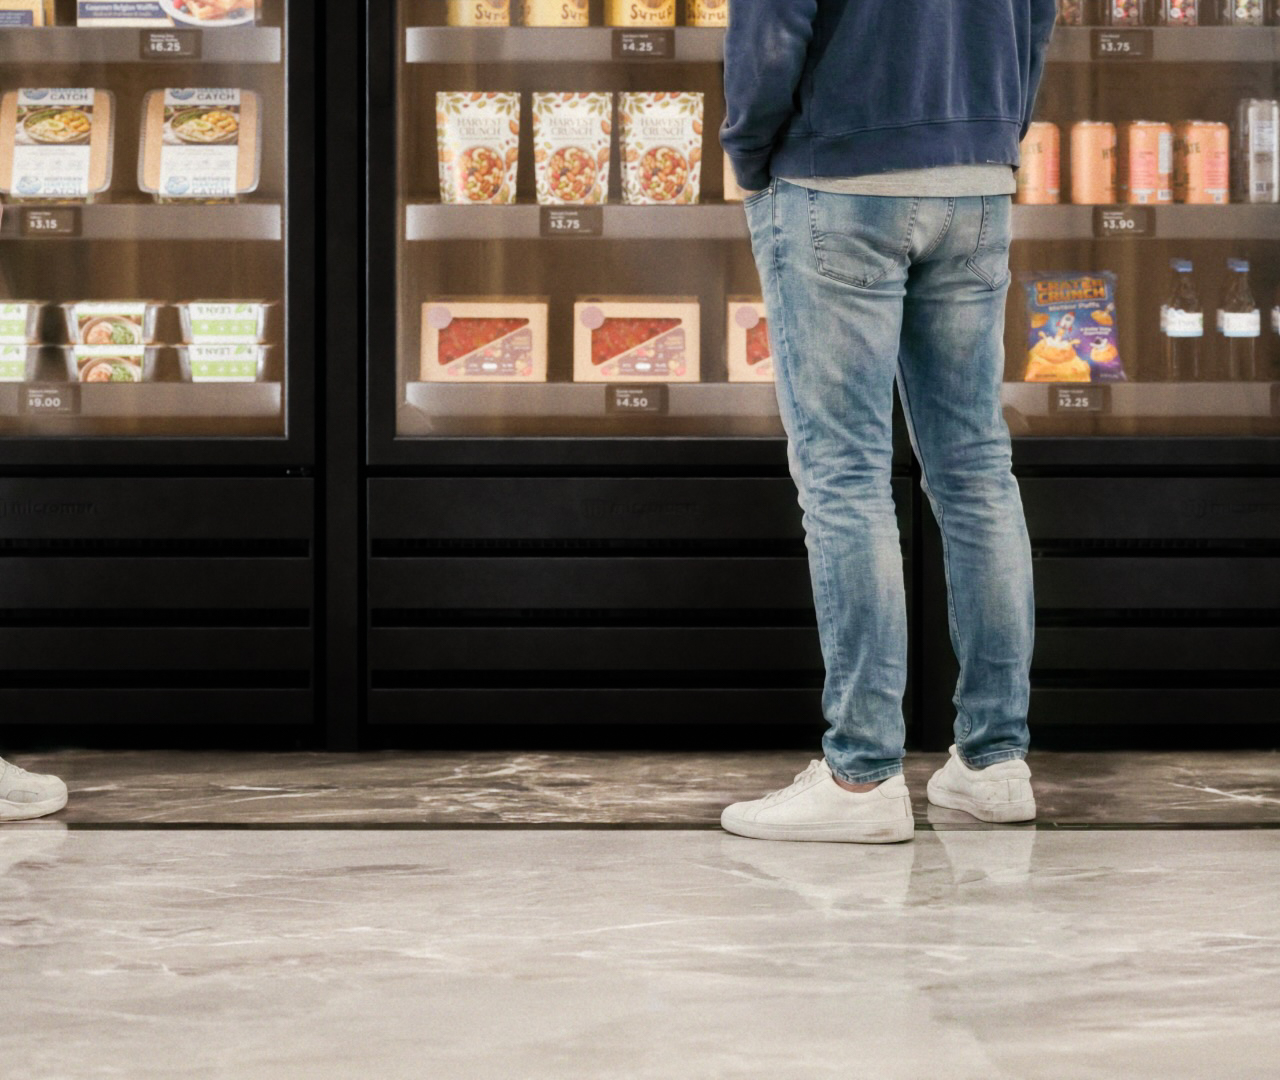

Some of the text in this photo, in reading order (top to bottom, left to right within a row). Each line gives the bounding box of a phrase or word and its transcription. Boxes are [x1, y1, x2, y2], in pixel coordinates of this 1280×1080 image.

[150, 42, 181, 52] $6.25
[622, 42, 653, 52] $4.25
[1101, 42, 1130, 52] $3.75
[49, 93, 88, 101] CATCH
[196, 93, 235, 101] CATCH
[30, 219, 58, 229] $3.15
[551, 219, 580, 229] $3.75
[1103, 219, 1135, 229] $3.90
[1037, 287, 1105, 304] CRUNCH
[29, 397, 61, 407] $9.00
[616, 398, 648, 407] $4.50
[1059, 398, 1089, 407] $2.25
